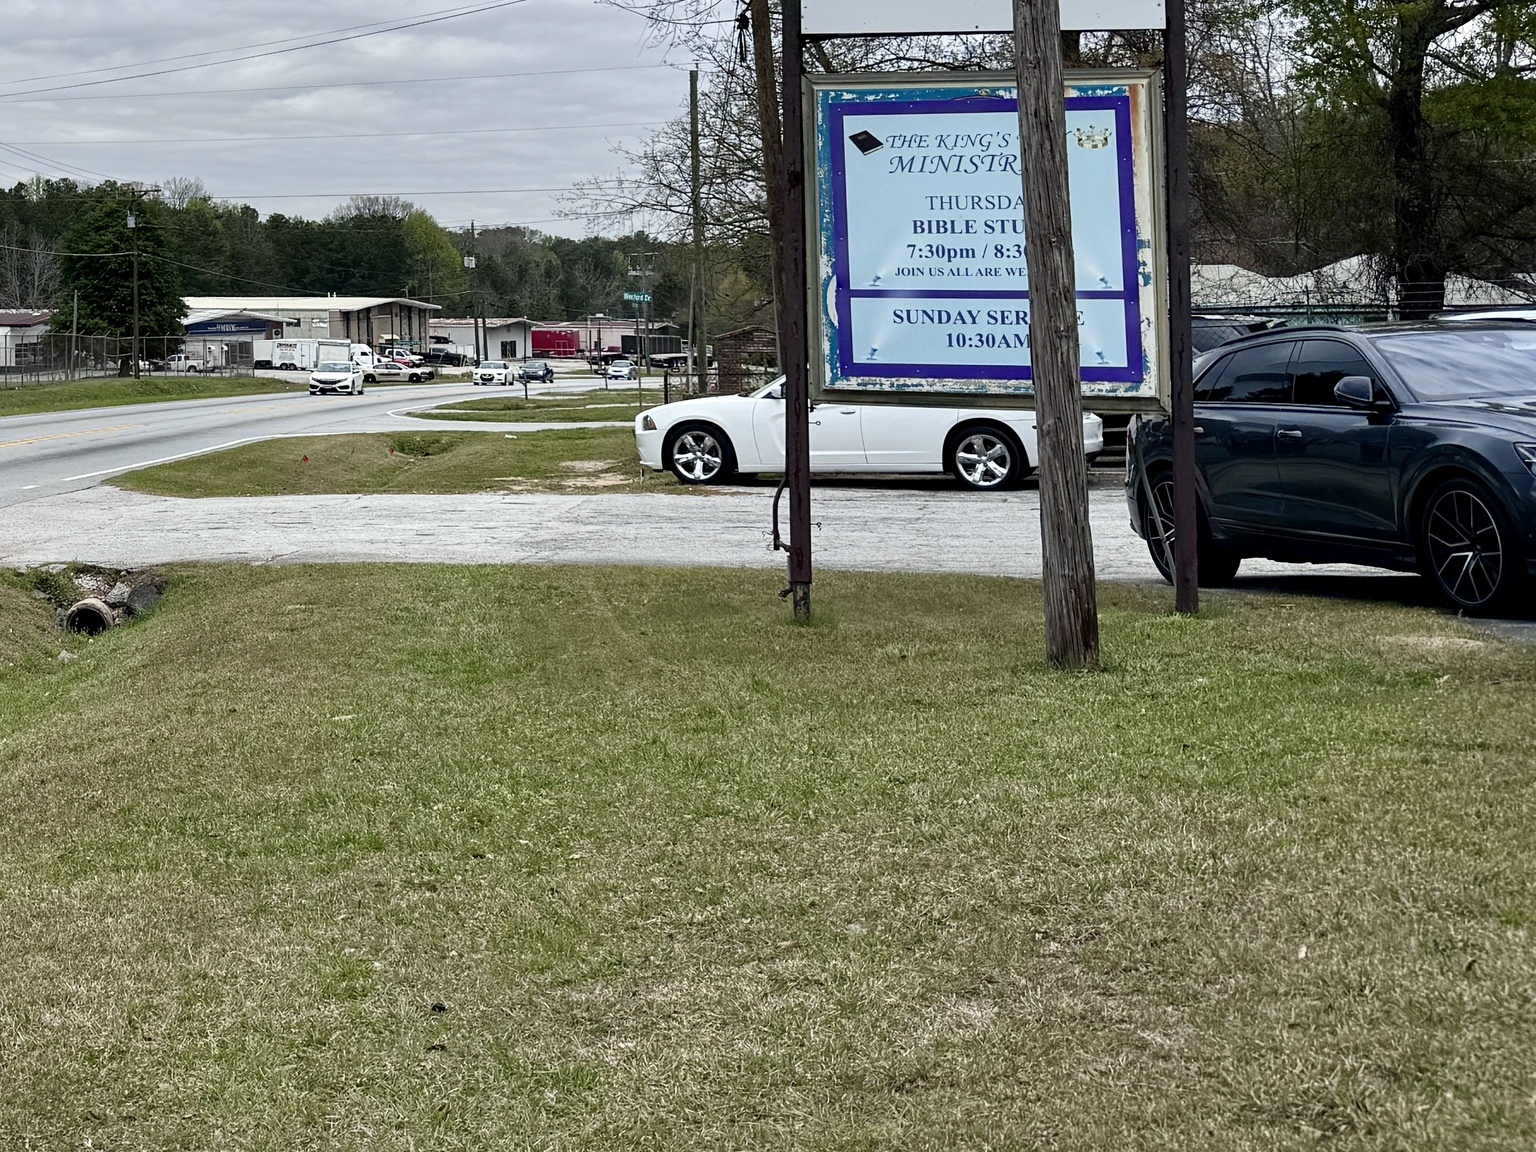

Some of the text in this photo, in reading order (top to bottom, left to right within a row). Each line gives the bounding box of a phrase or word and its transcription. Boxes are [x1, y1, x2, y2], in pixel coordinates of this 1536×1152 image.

[885, 134, 930, 149] THE
[934, 131, 1011, 152] KING'S
[889, 154, 1022, 176] MINISTR
[925, 195, 1026, 210] THURSDA
[912, 219, 1026, 235] BIBLE STU
[906, 243, 976, 263] 7:30pm
[982, 243, 988, 259] /
[895, 267, 925, 277] JOIN
[928, 267, 945, 277] US
[948, 267, 973, 277] ALL
[975, 267, 1002, 277] ARE
[893, 309, 1085, 326] SUNDAY SERE
[946, 332, 1031, 349] 10:30AM
